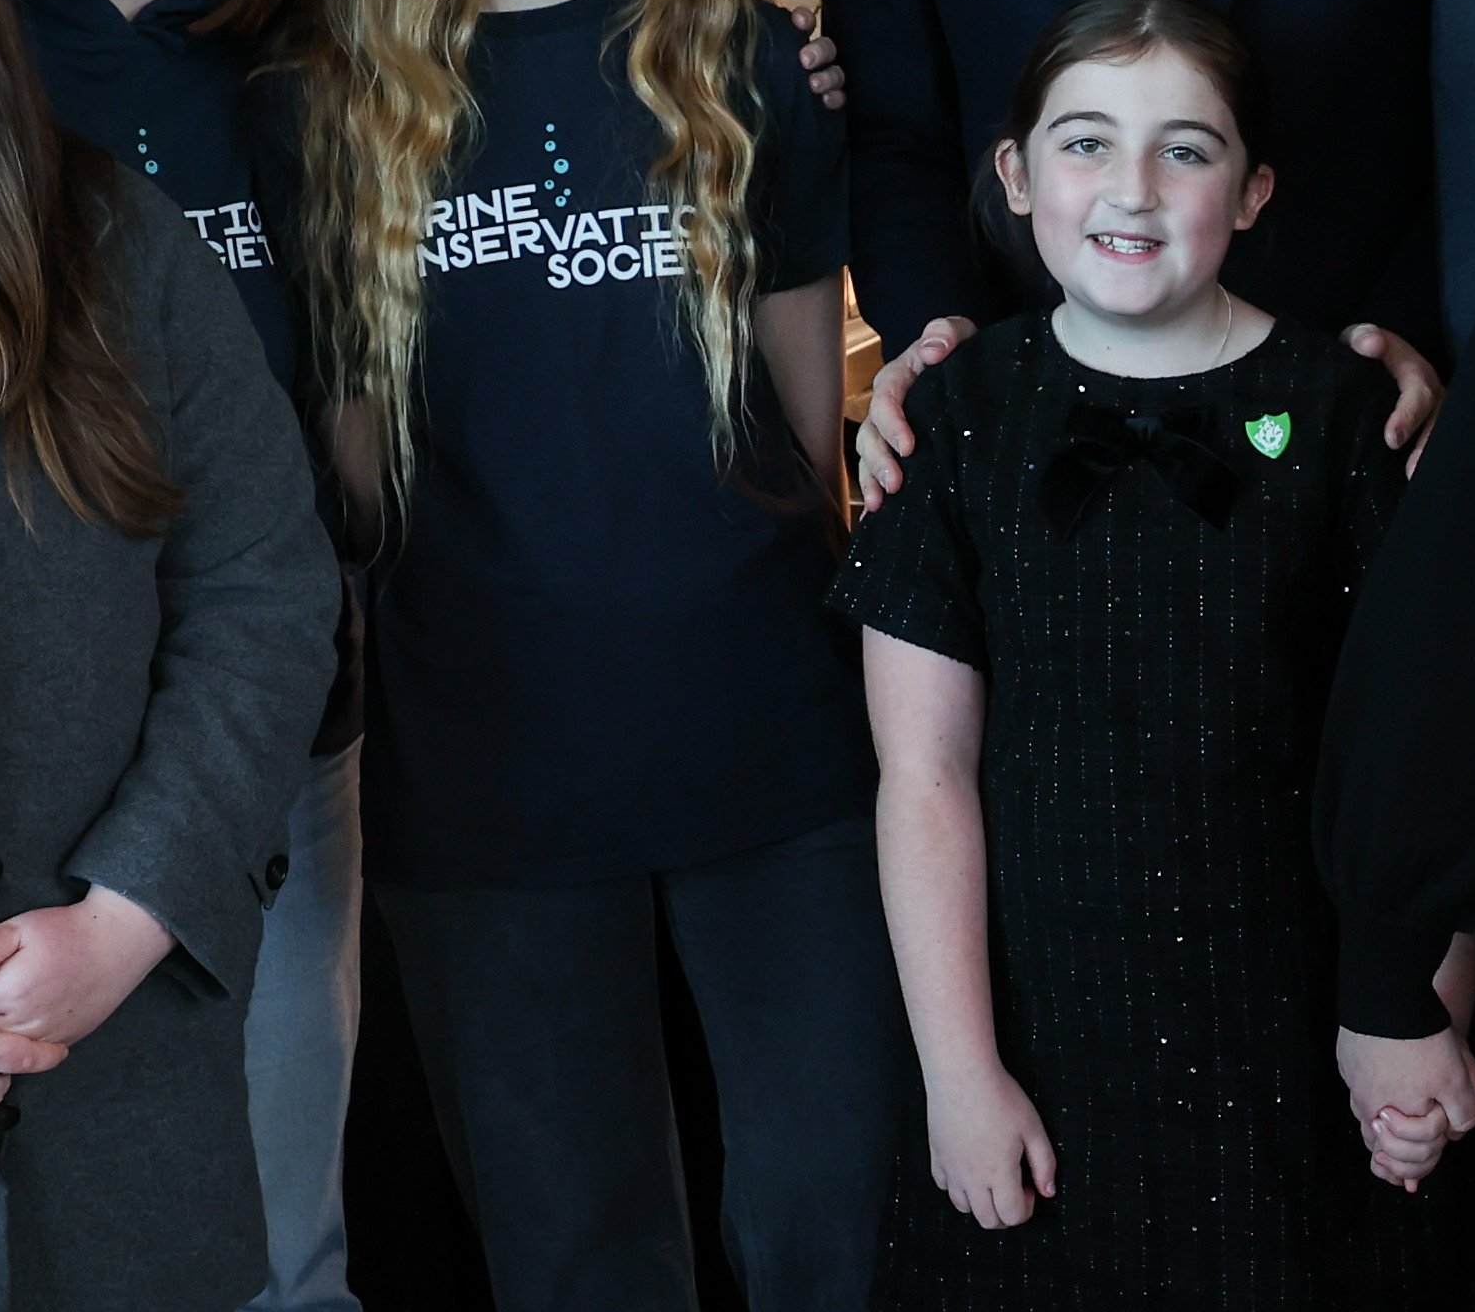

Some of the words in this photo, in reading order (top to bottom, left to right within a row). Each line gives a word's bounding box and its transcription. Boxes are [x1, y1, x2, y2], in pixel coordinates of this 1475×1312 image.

[424, 183, 540, 238] RINE
[416, 204, 697, 278] NSERVATIO
[547, 242, 690, 289] SOCIE
